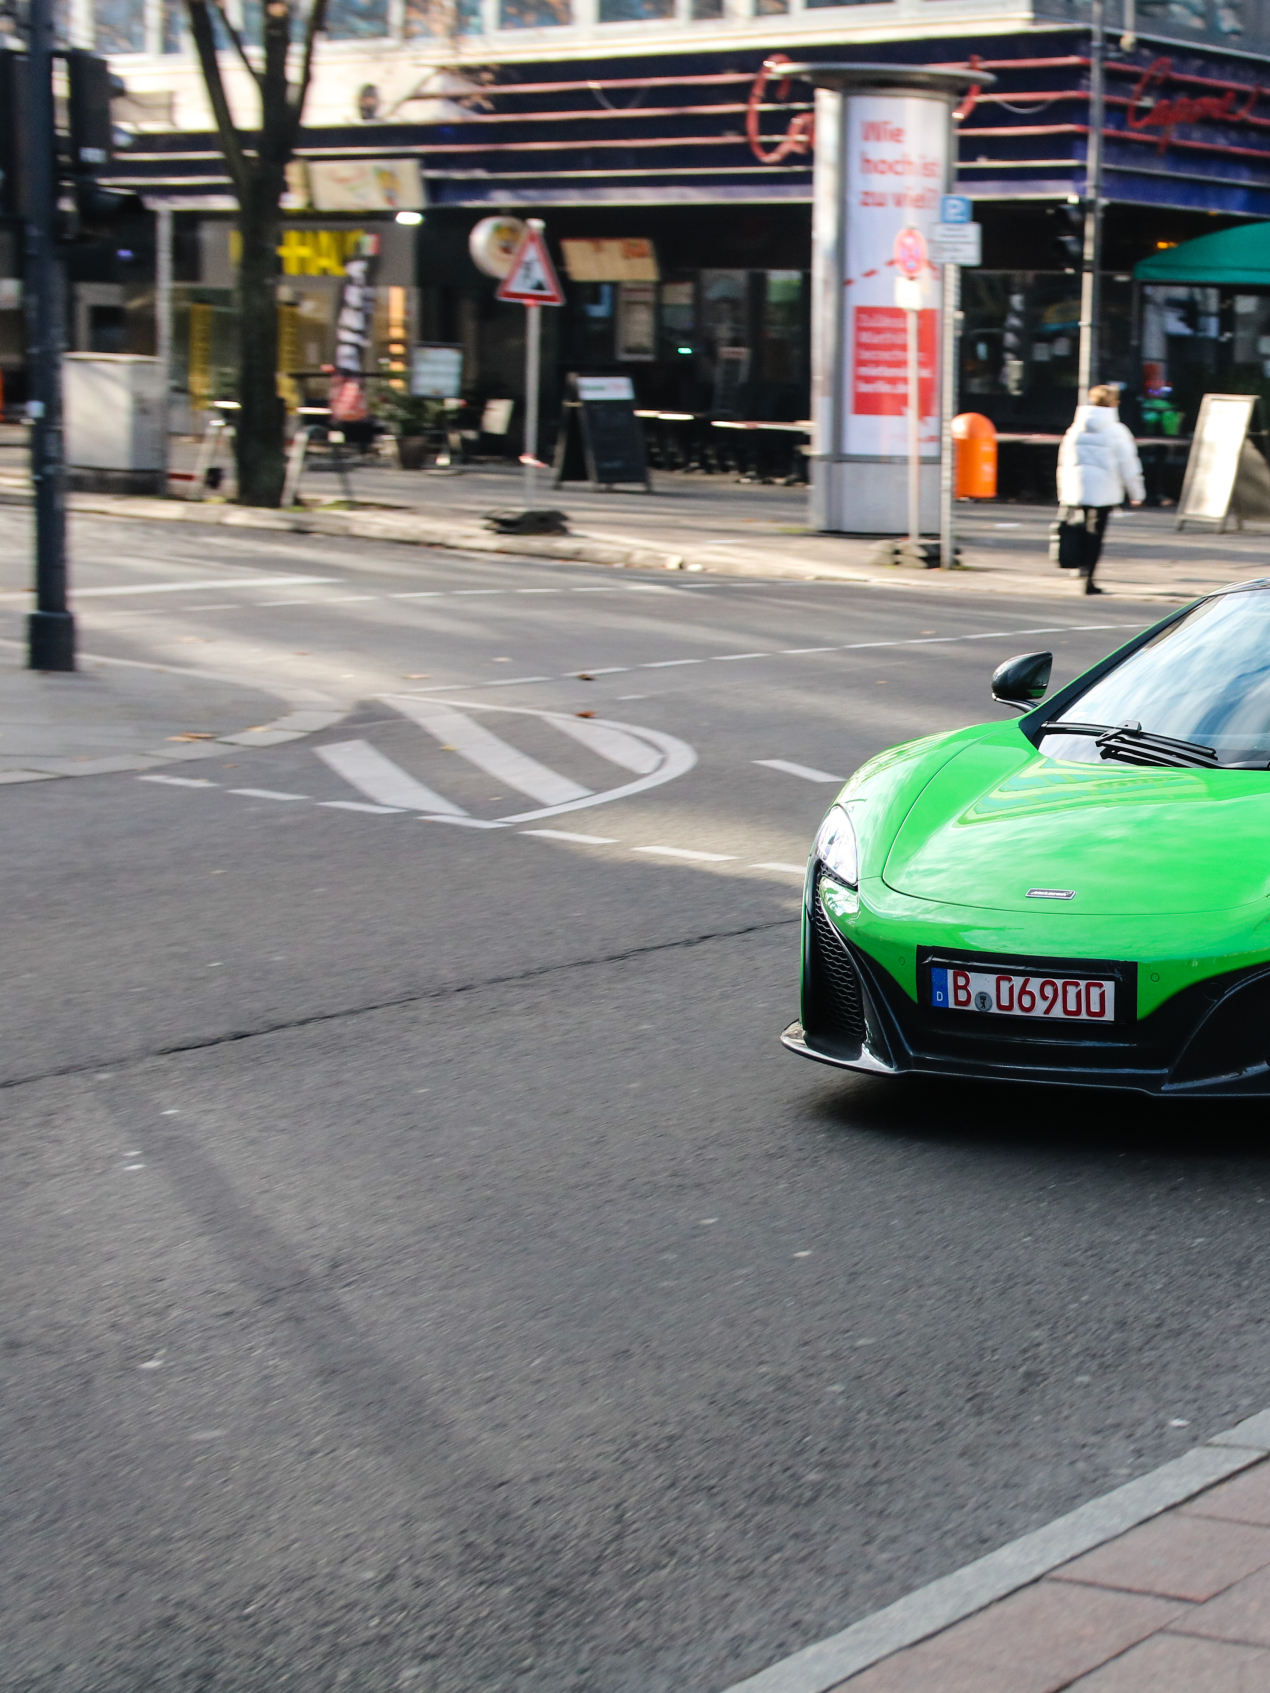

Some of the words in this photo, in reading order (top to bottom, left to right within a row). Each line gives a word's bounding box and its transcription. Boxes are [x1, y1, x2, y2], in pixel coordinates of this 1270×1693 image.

[861, 120, 904, 142] Wie
[861, 151, 914, 175] hoch
[861, 190, 886, 206] zu
[946, 199, 965, 220] P
[936, 991, 944, 1002] D
[952, 970, 973, 1007] B
[995, 974, 1107, 1018] 06900
